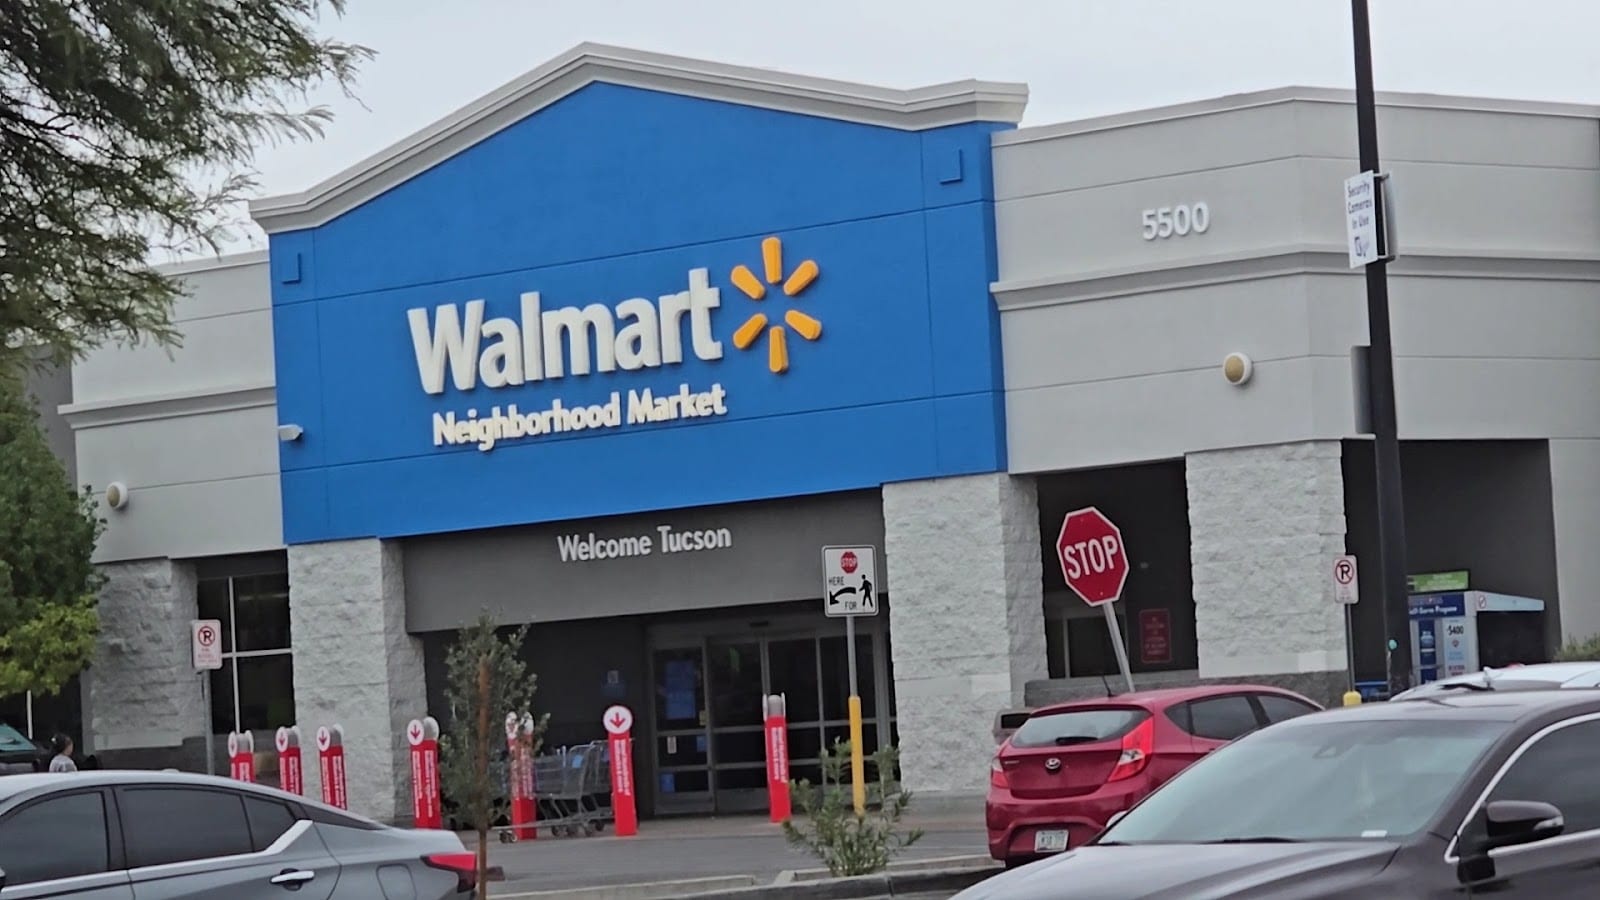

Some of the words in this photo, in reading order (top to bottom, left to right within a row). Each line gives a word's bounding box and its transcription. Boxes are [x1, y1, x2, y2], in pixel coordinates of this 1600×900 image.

[1347, 182, 1371, 198] Security
[1142, 201, 1210, 240] 5500
[1347, 200, 1373, 214] Cameras
[407, 267, 724, 396] Walmart
[432, 390, 622, 451] Neighborhood
[626, 383, 728, 425] Market
[557, 531, 653, 563] Welcome
[656, 525, 732, 554] Tucson
[1063, 535, 1119, 579] STOP
[841, 557, 857, 568] STOP
[828, 576, 846, 586] HERE
[844, 600, 857, 610] FOR
